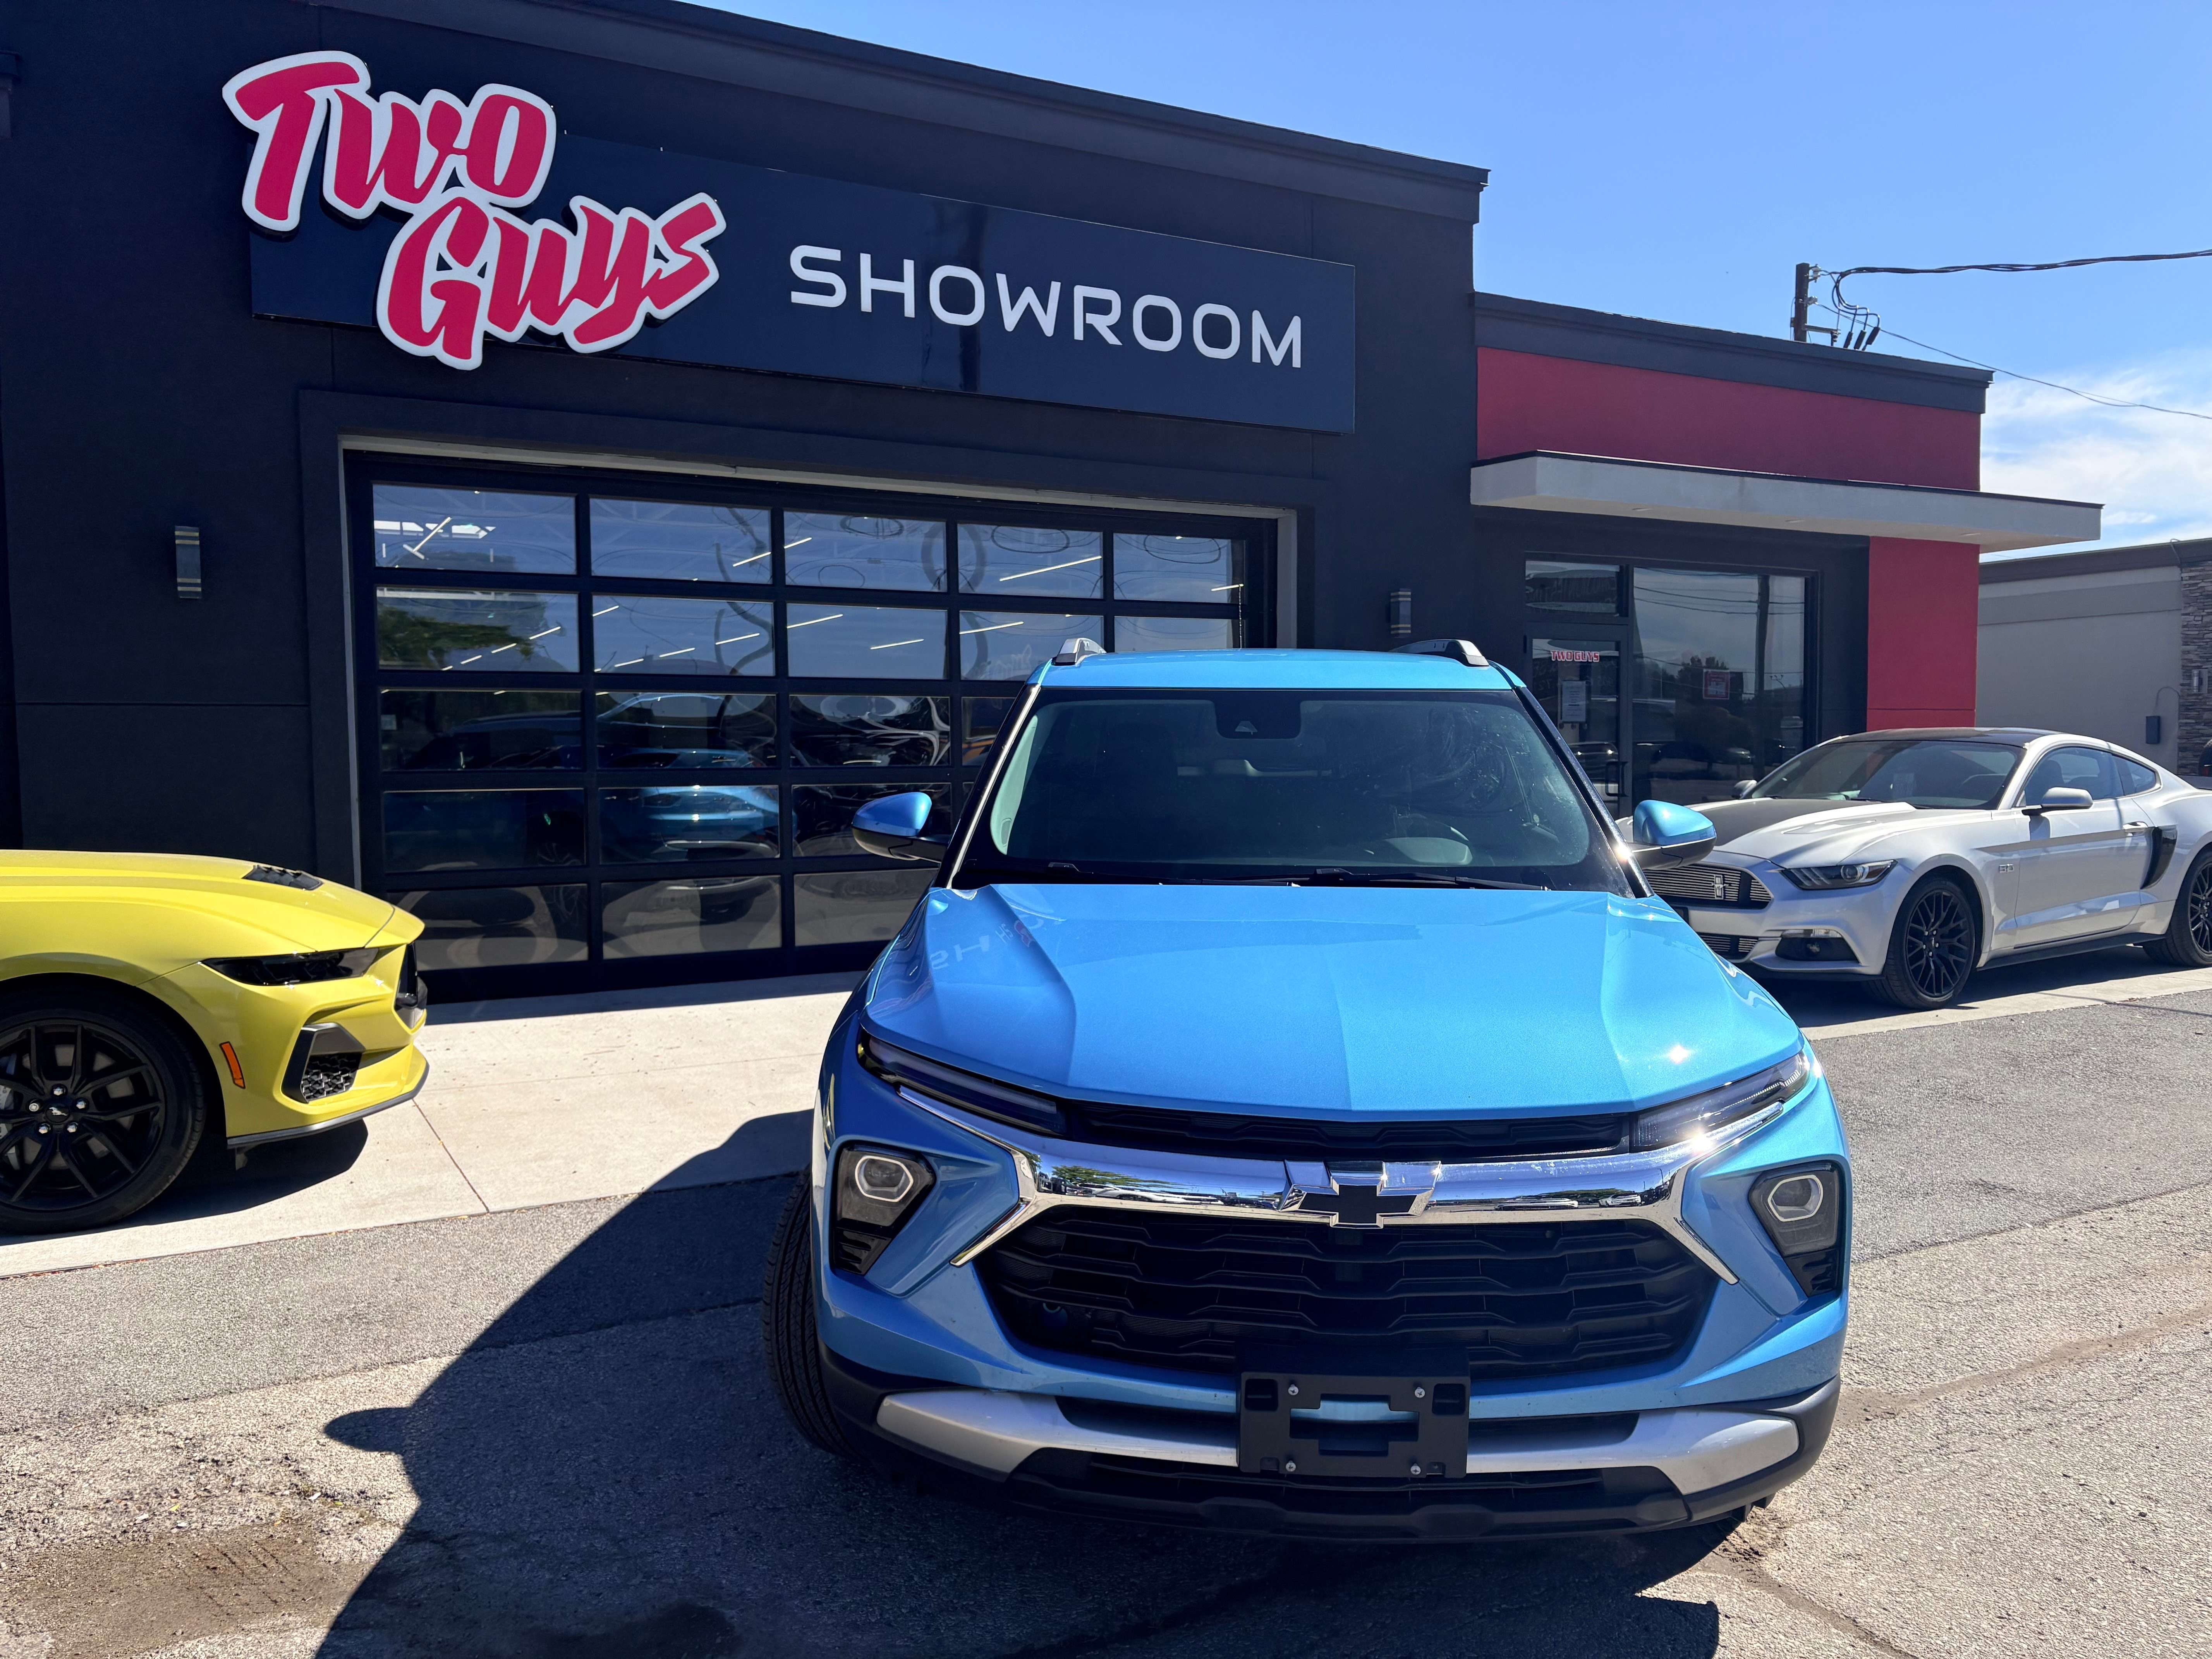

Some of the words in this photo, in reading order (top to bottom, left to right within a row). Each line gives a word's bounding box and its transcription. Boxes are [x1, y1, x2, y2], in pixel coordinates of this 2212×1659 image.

[223, 50, 556, 231] Two
[376, 186, 726, 370] Guys
[790, 244, 1301, 368] SHOWROOM
[1551, 650, 1573, 661] TWO
[1574, 651, 1599, 662] GUYS
